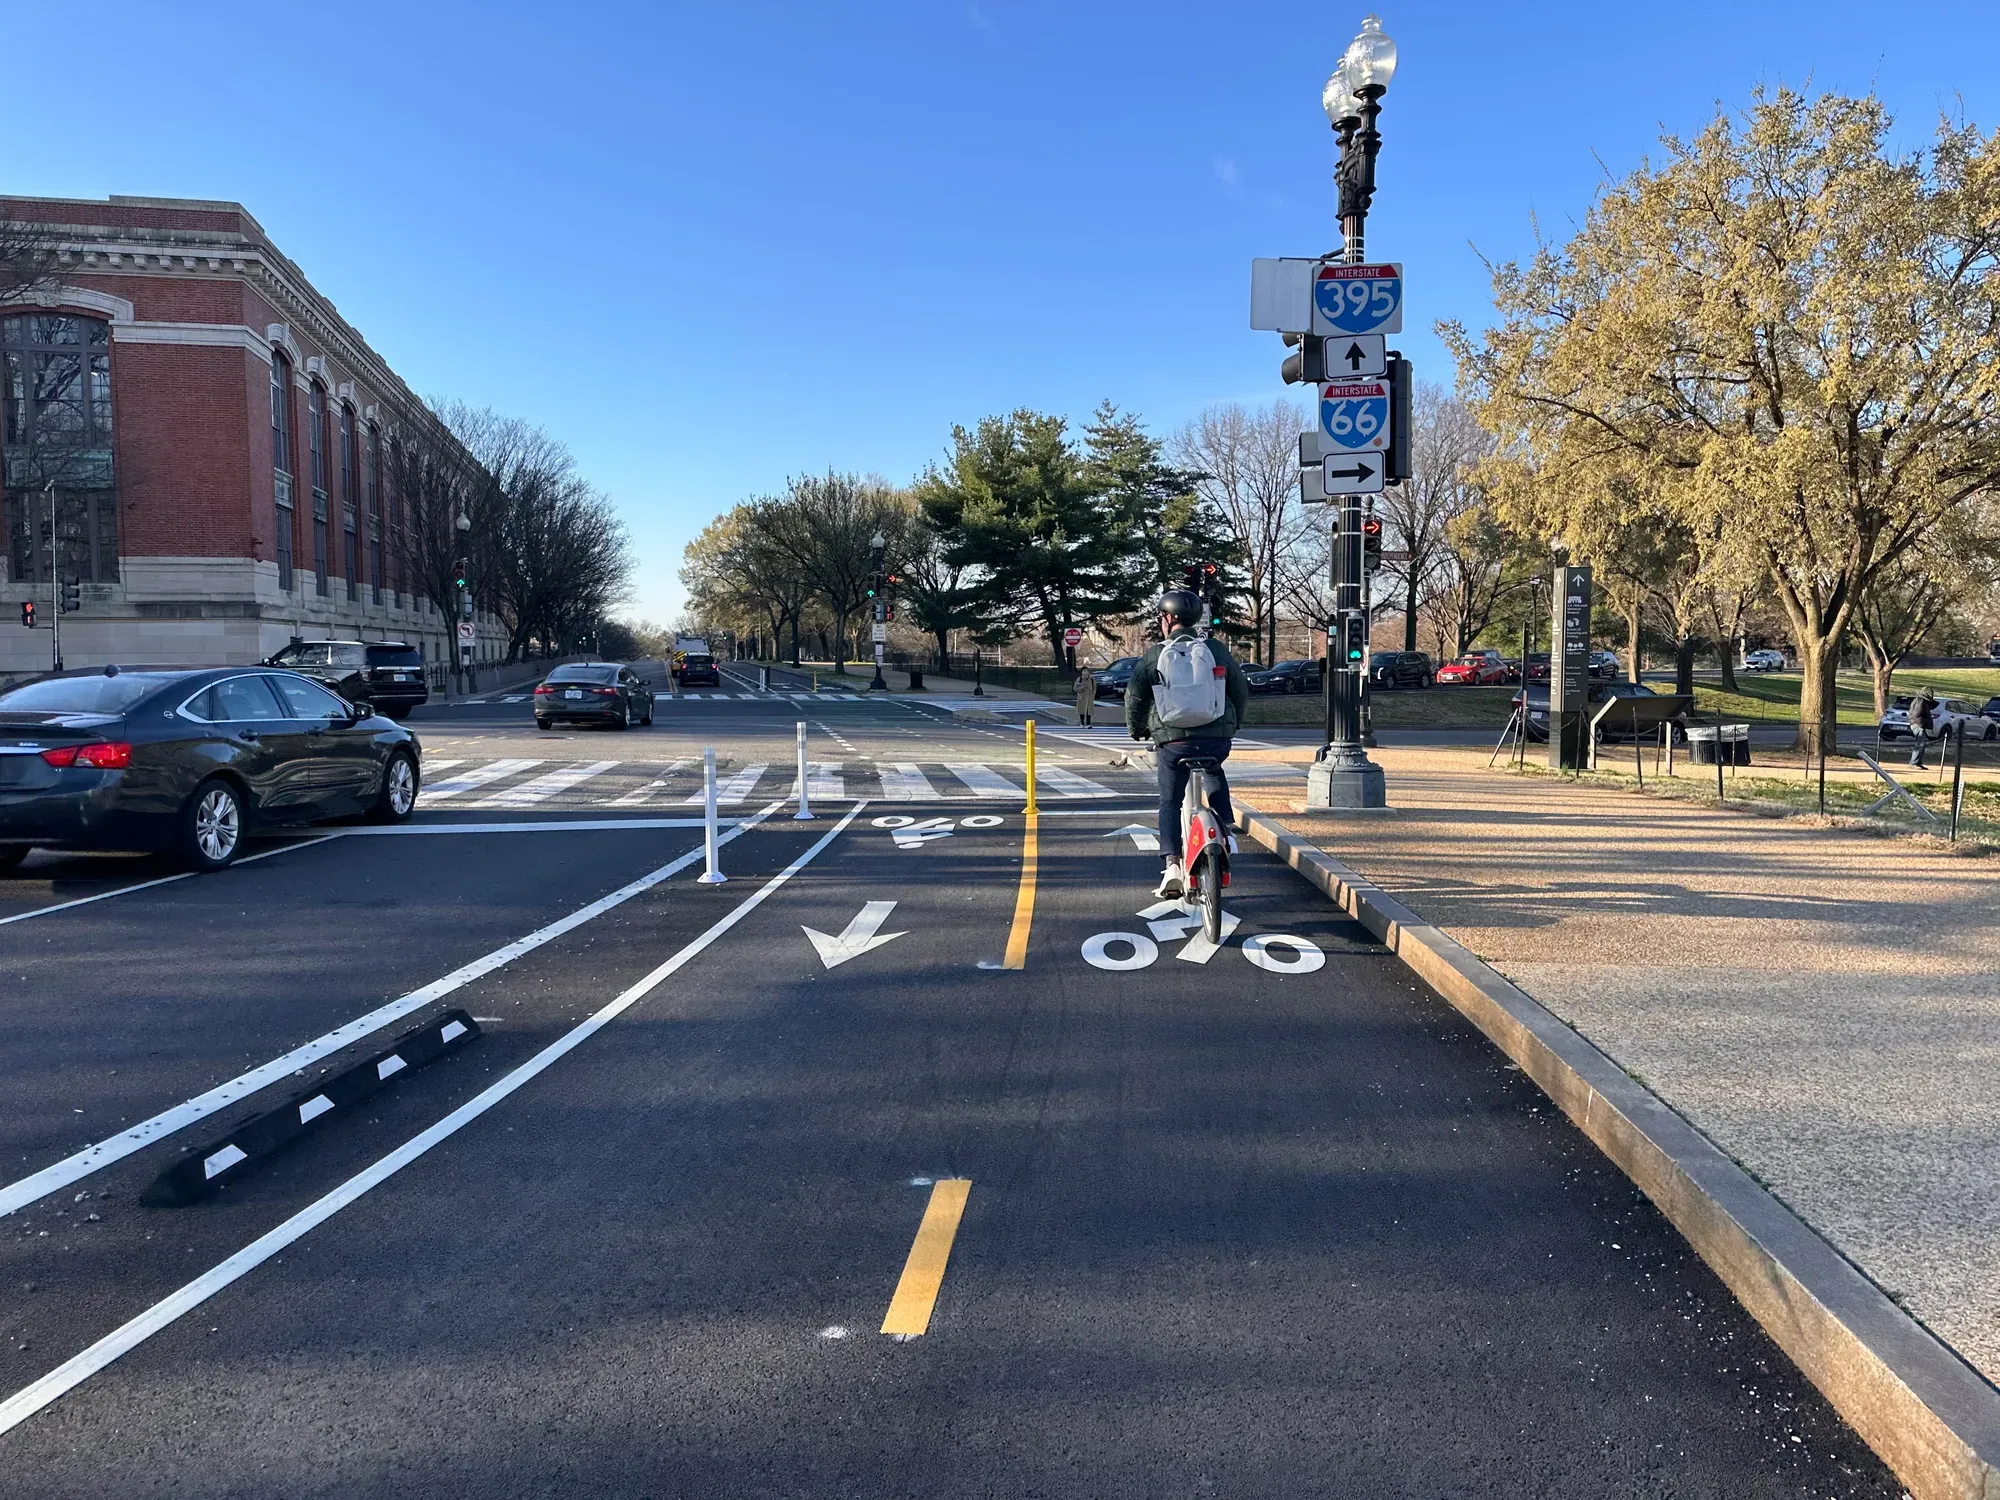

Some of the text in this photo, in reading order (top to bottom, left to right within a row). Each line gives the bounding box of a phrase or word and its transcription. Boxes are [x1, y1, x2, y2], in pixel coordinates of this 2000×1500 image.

[1336, 268, 1380, 278] INTERSTATE
[1321, 281, 1394, 318] 395
[1332, 386, 1377, 396] INTERSTATE
[1331, 401, 1378, 435] 66
